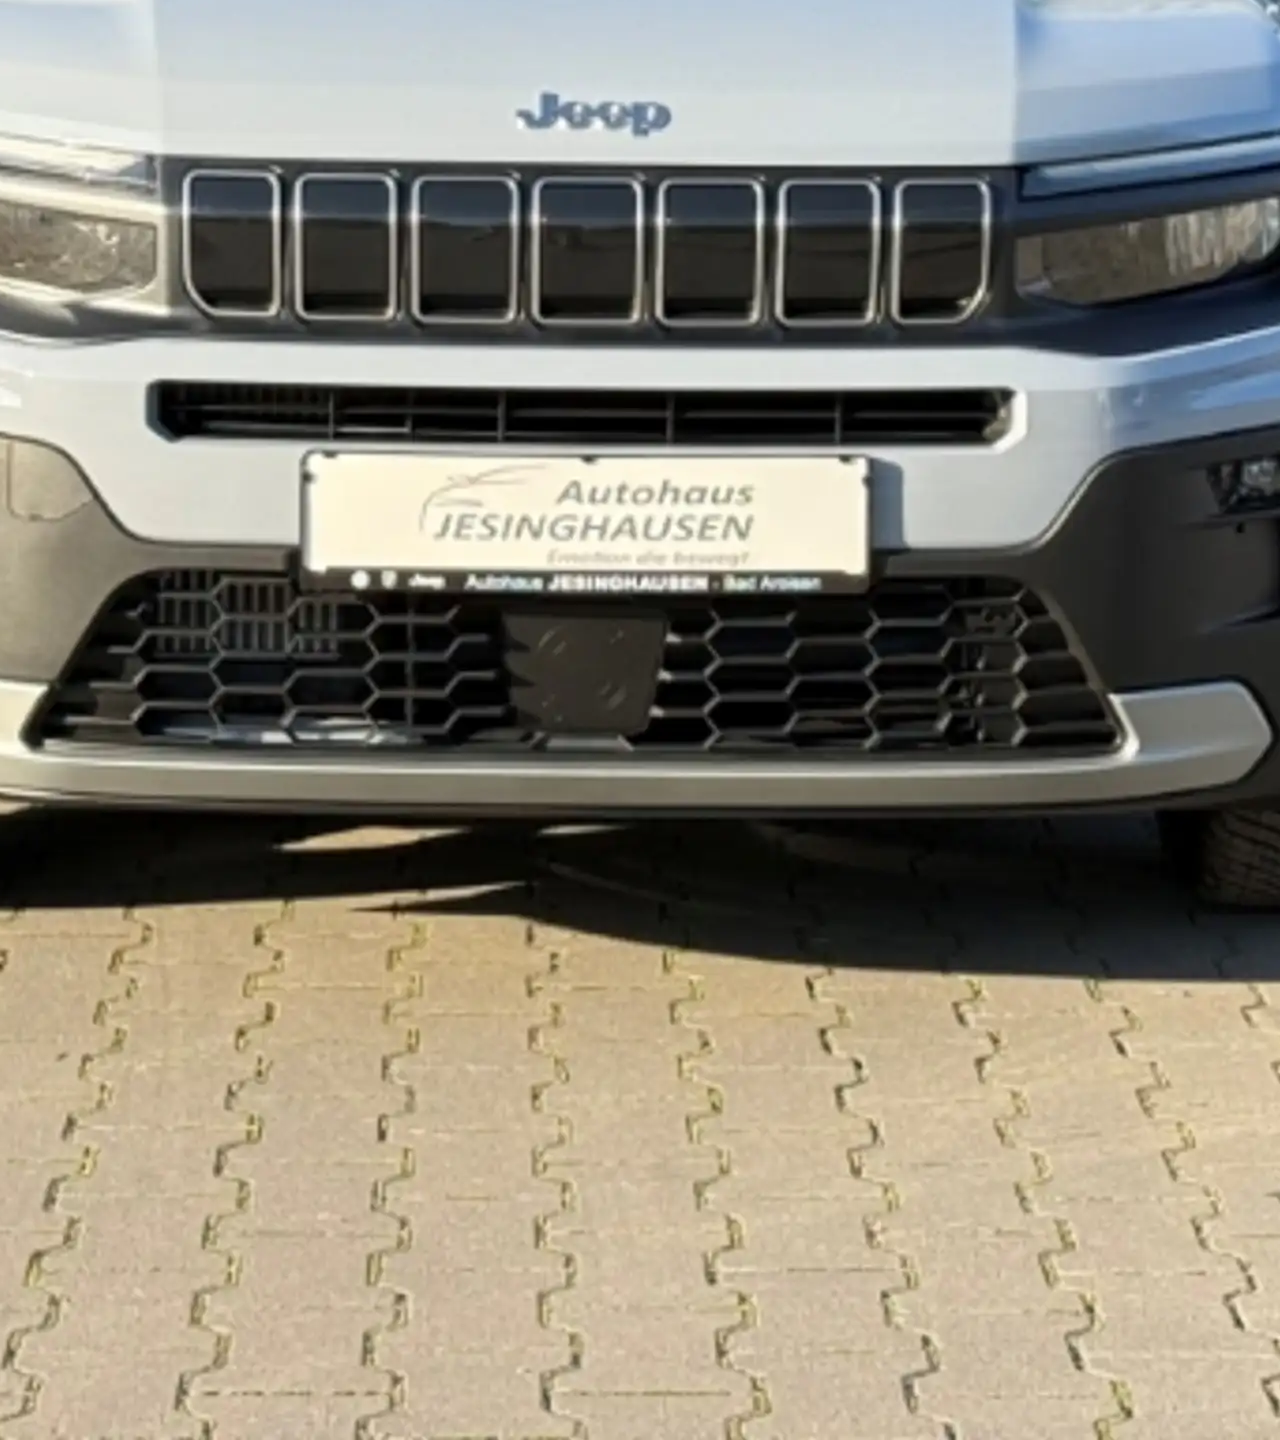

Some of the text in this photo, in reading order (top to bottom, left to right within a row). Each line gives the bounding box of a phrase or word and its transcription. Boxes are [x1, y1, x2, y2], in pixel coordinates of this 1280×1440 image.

[516, 93, 671, 136] Jeep
[556, 479, 754, 506] Autohaus
[433, 513, 754, 542] JESINGHAUSEN
[464, 574, 543, 591] Autohaus
[548, 574, 709, 591] JESINGHAUSEN
[723, 574, 757, 591] Bad
